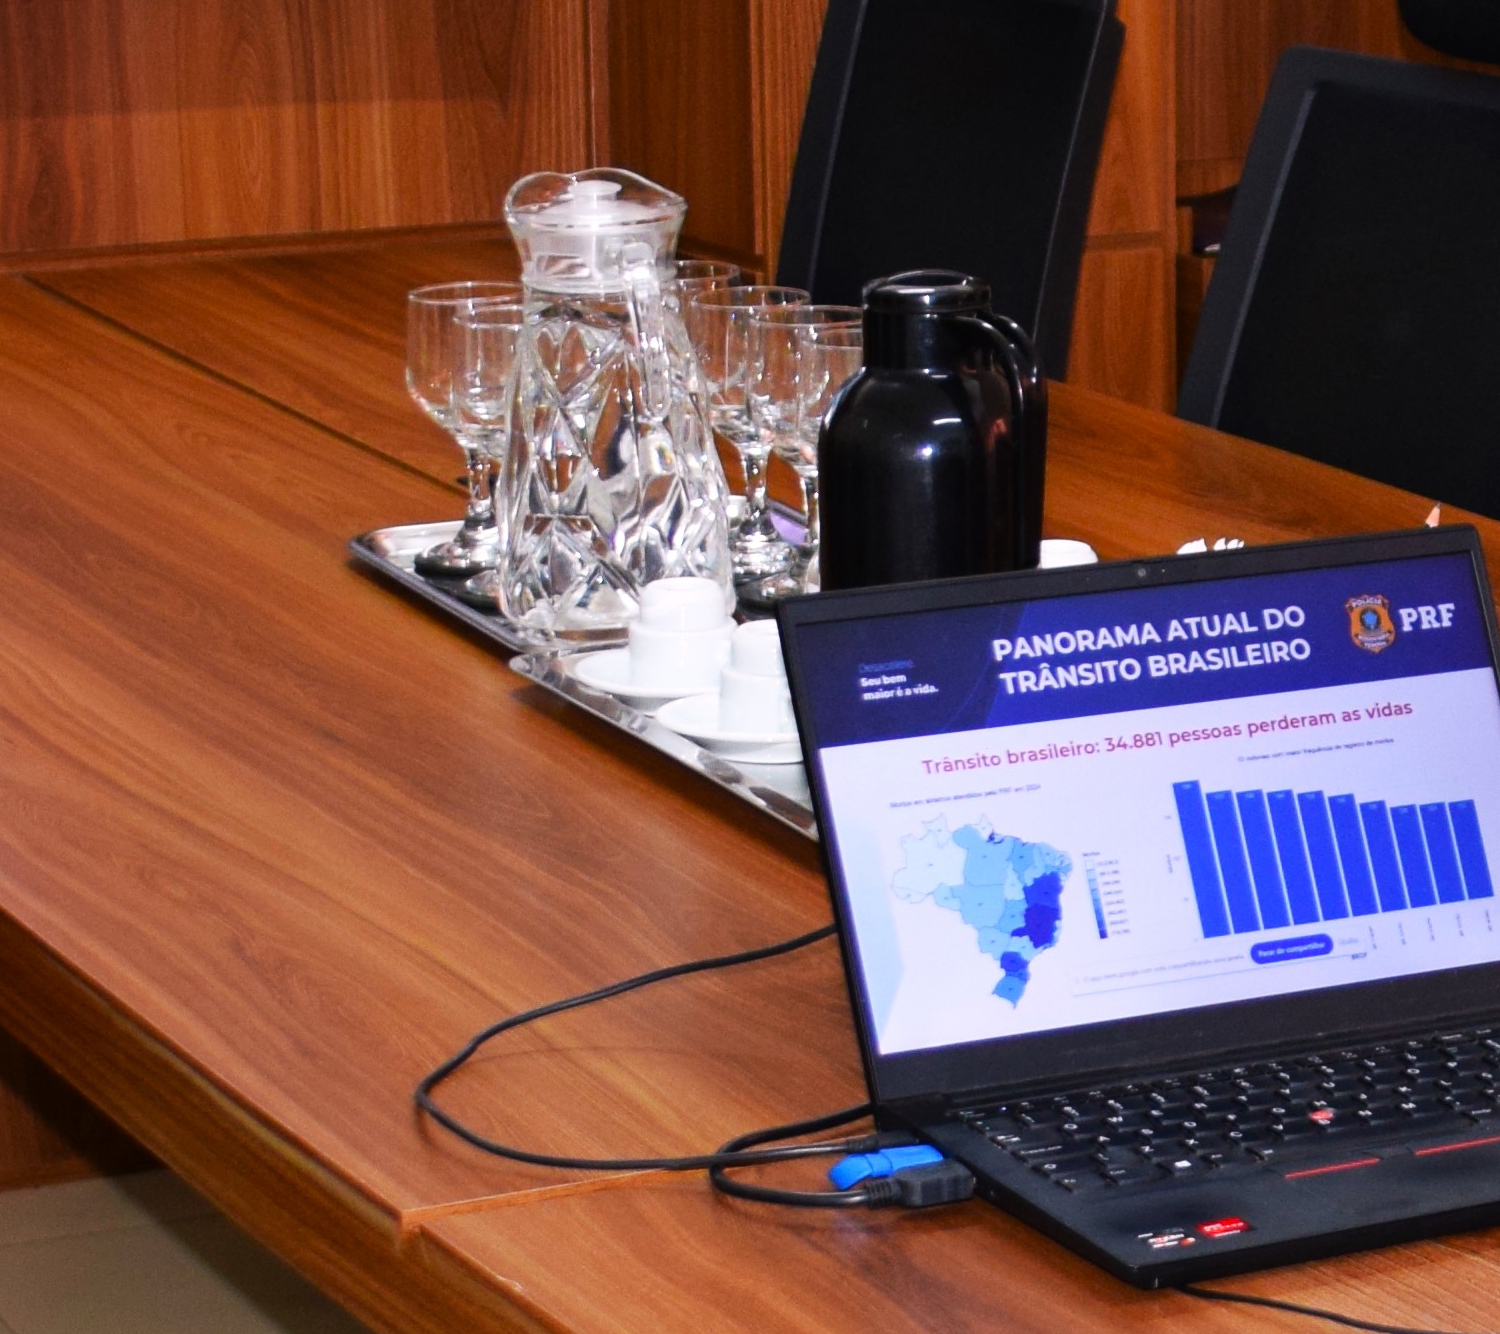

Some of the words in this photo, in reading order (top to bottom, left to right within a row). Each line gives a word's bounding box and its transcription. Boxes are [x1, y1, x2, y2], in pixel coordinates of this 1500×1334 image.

[992, 621, 1161, 662] PANORAMA
[1167, 610, 1259, 644] ATUAL
[1262, 604, 1306, 631] DO
[1398, 602, 1456, 633] PRF
[999, 657, 1142, 695] TRÂNSITO
[1148, 637, 1312, 679] BRASILEIRO
[921, 750, 1003, 777] Trânsito
[1006, 738, 1102, 766] brasileiro:
[1104, 730, 1164, 754] 34.881
[1168, 721, 1243, 748] pessoas
[1247, 709, 1338, 740] perderam
[1341, 707, 1362, 723] as
[1365, 699, 1413, 720] vidas
